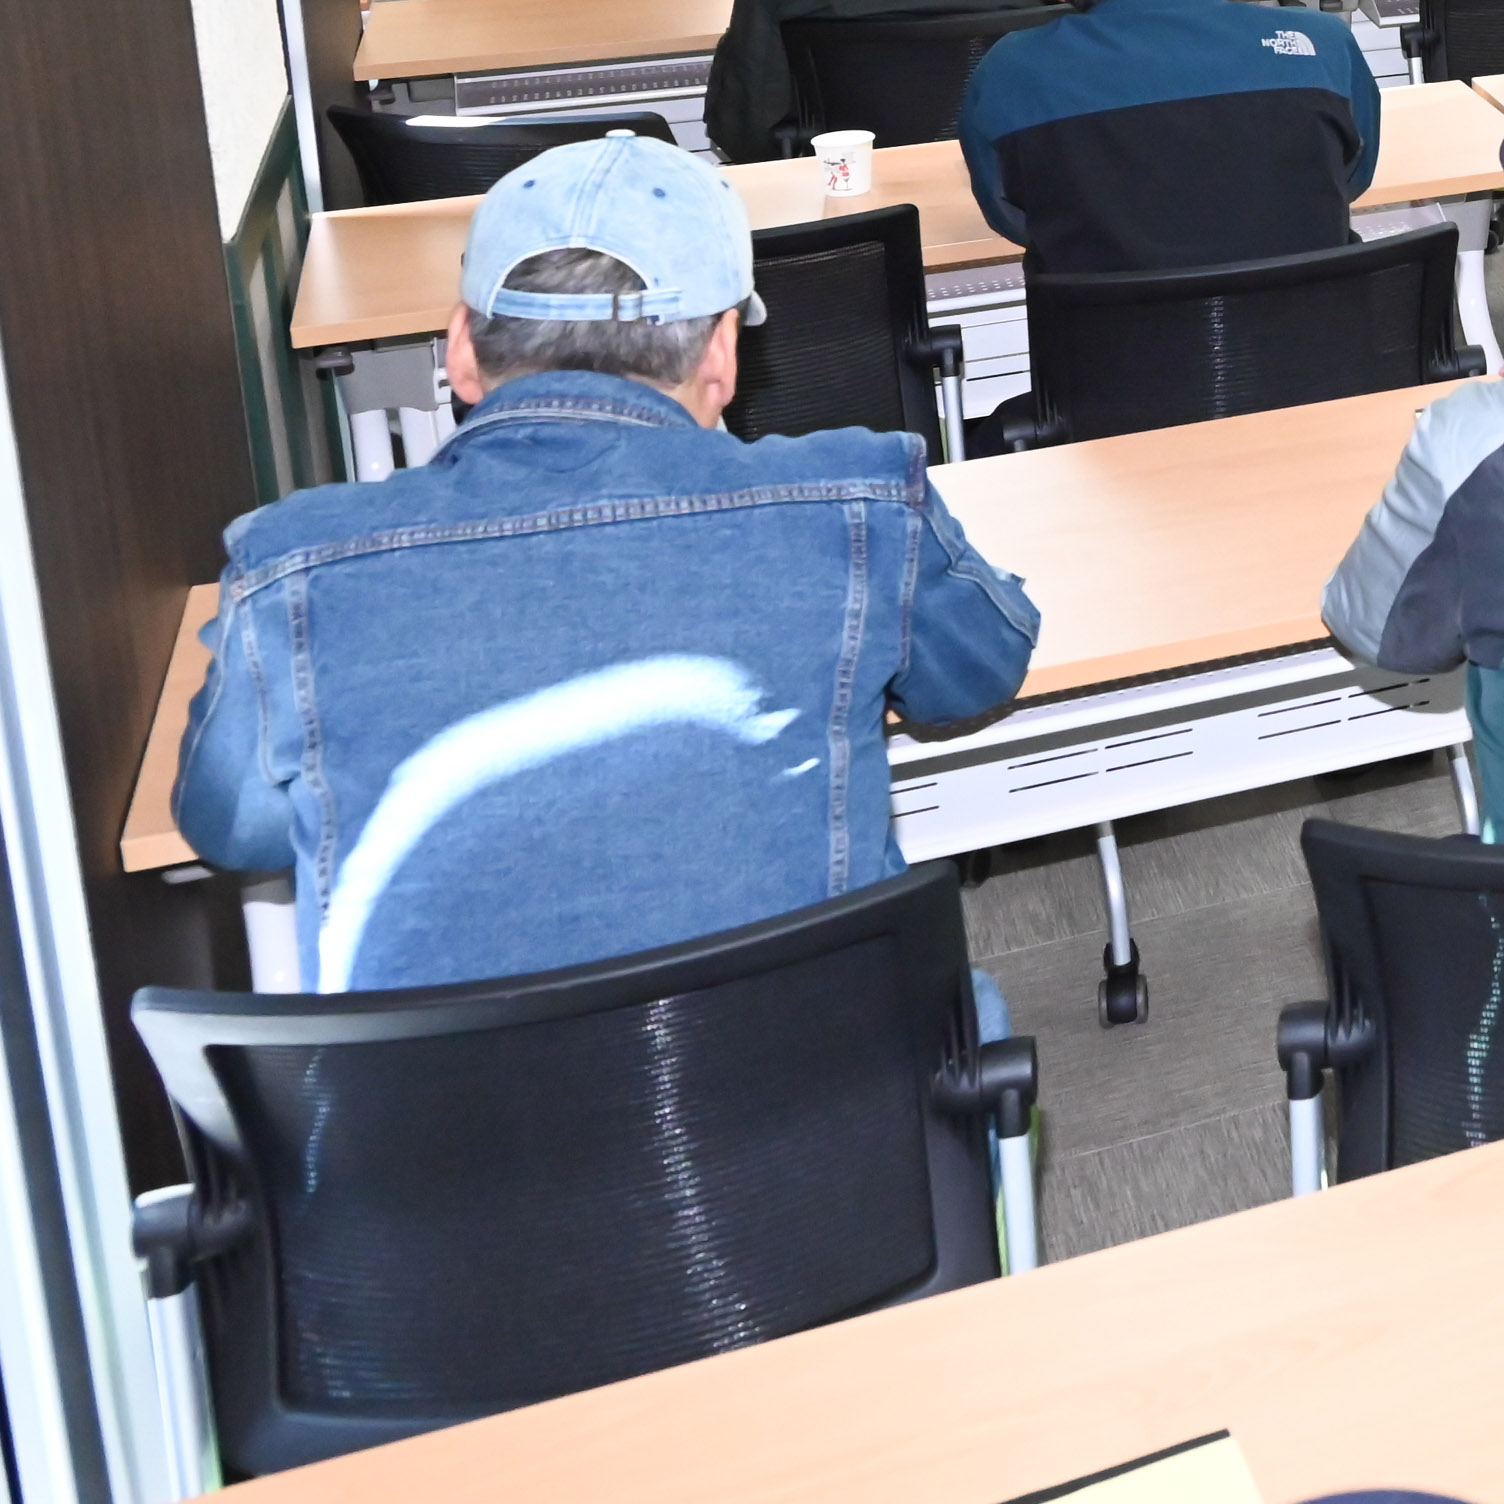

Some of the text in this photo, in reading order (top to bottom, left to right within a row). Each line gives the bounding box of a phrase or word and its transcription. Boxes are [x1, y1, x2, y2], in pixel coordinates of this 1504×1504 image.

[1275, 30, 1295, 39] THE
[1261, 38, 1297, 48] NORTH
[1274, 46, 1298, 56] FACE
